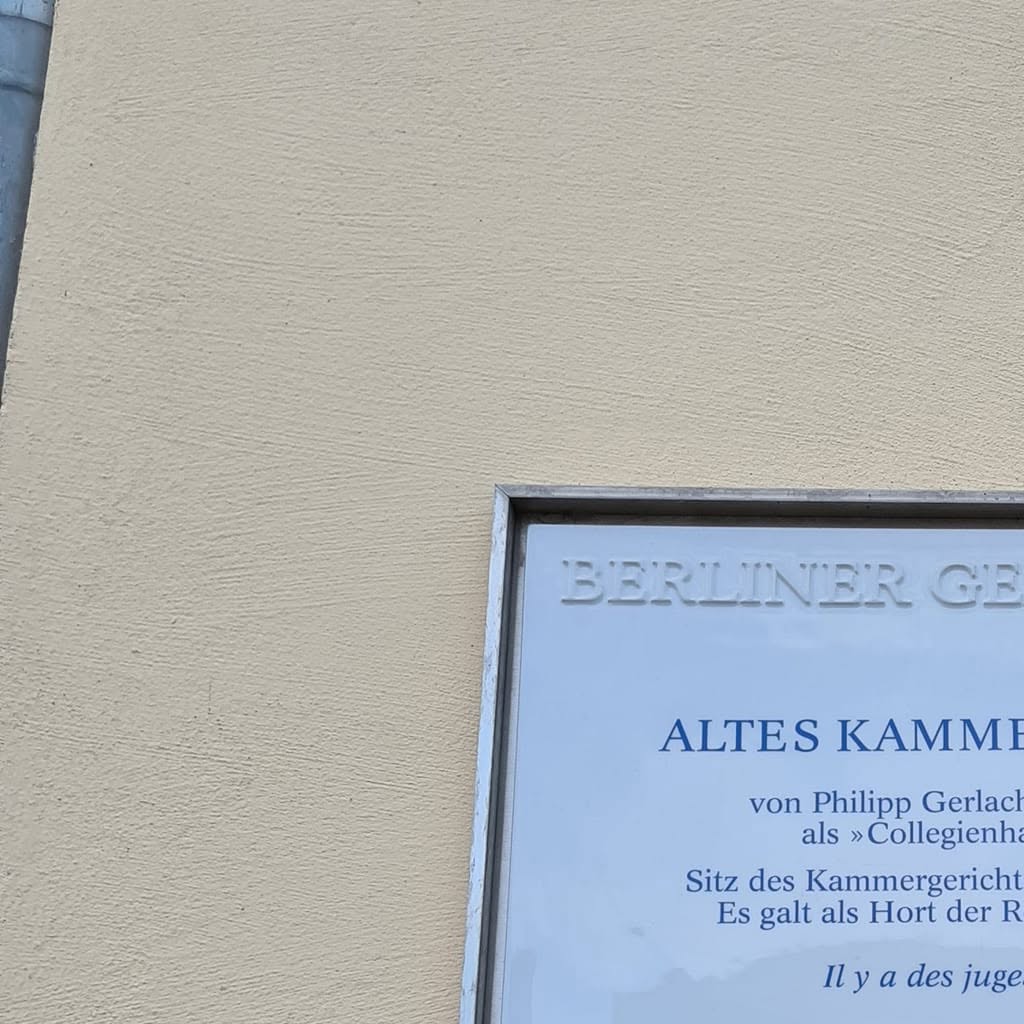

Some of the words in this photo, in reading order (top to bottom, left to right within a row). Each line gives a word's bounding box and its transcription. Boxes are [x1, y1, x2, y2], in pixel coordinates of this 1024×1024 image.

[561, 559, 912, 607] BERLINER
[658, 718, 819, 753] ALTES
[749, 797, 802, 815] von
[812, 789, 912, 820] Philipp
[801, 820, 839, 845] als
[686, 868, 739, 893] Sitz
[748, 867, 795, 893] des
[716, 901, 751, 925] Es
[759, 899, 812, 931] galt
[821, 899, 859, 924] als
[869, 900, 937, 924] Hort
[946, 898, 992, 923] der
[823, 963, 846, 988] Il
[852, 970, 870, 995] y
[879, 970, 897, 988] a
[906, 962, 954, 988] des
